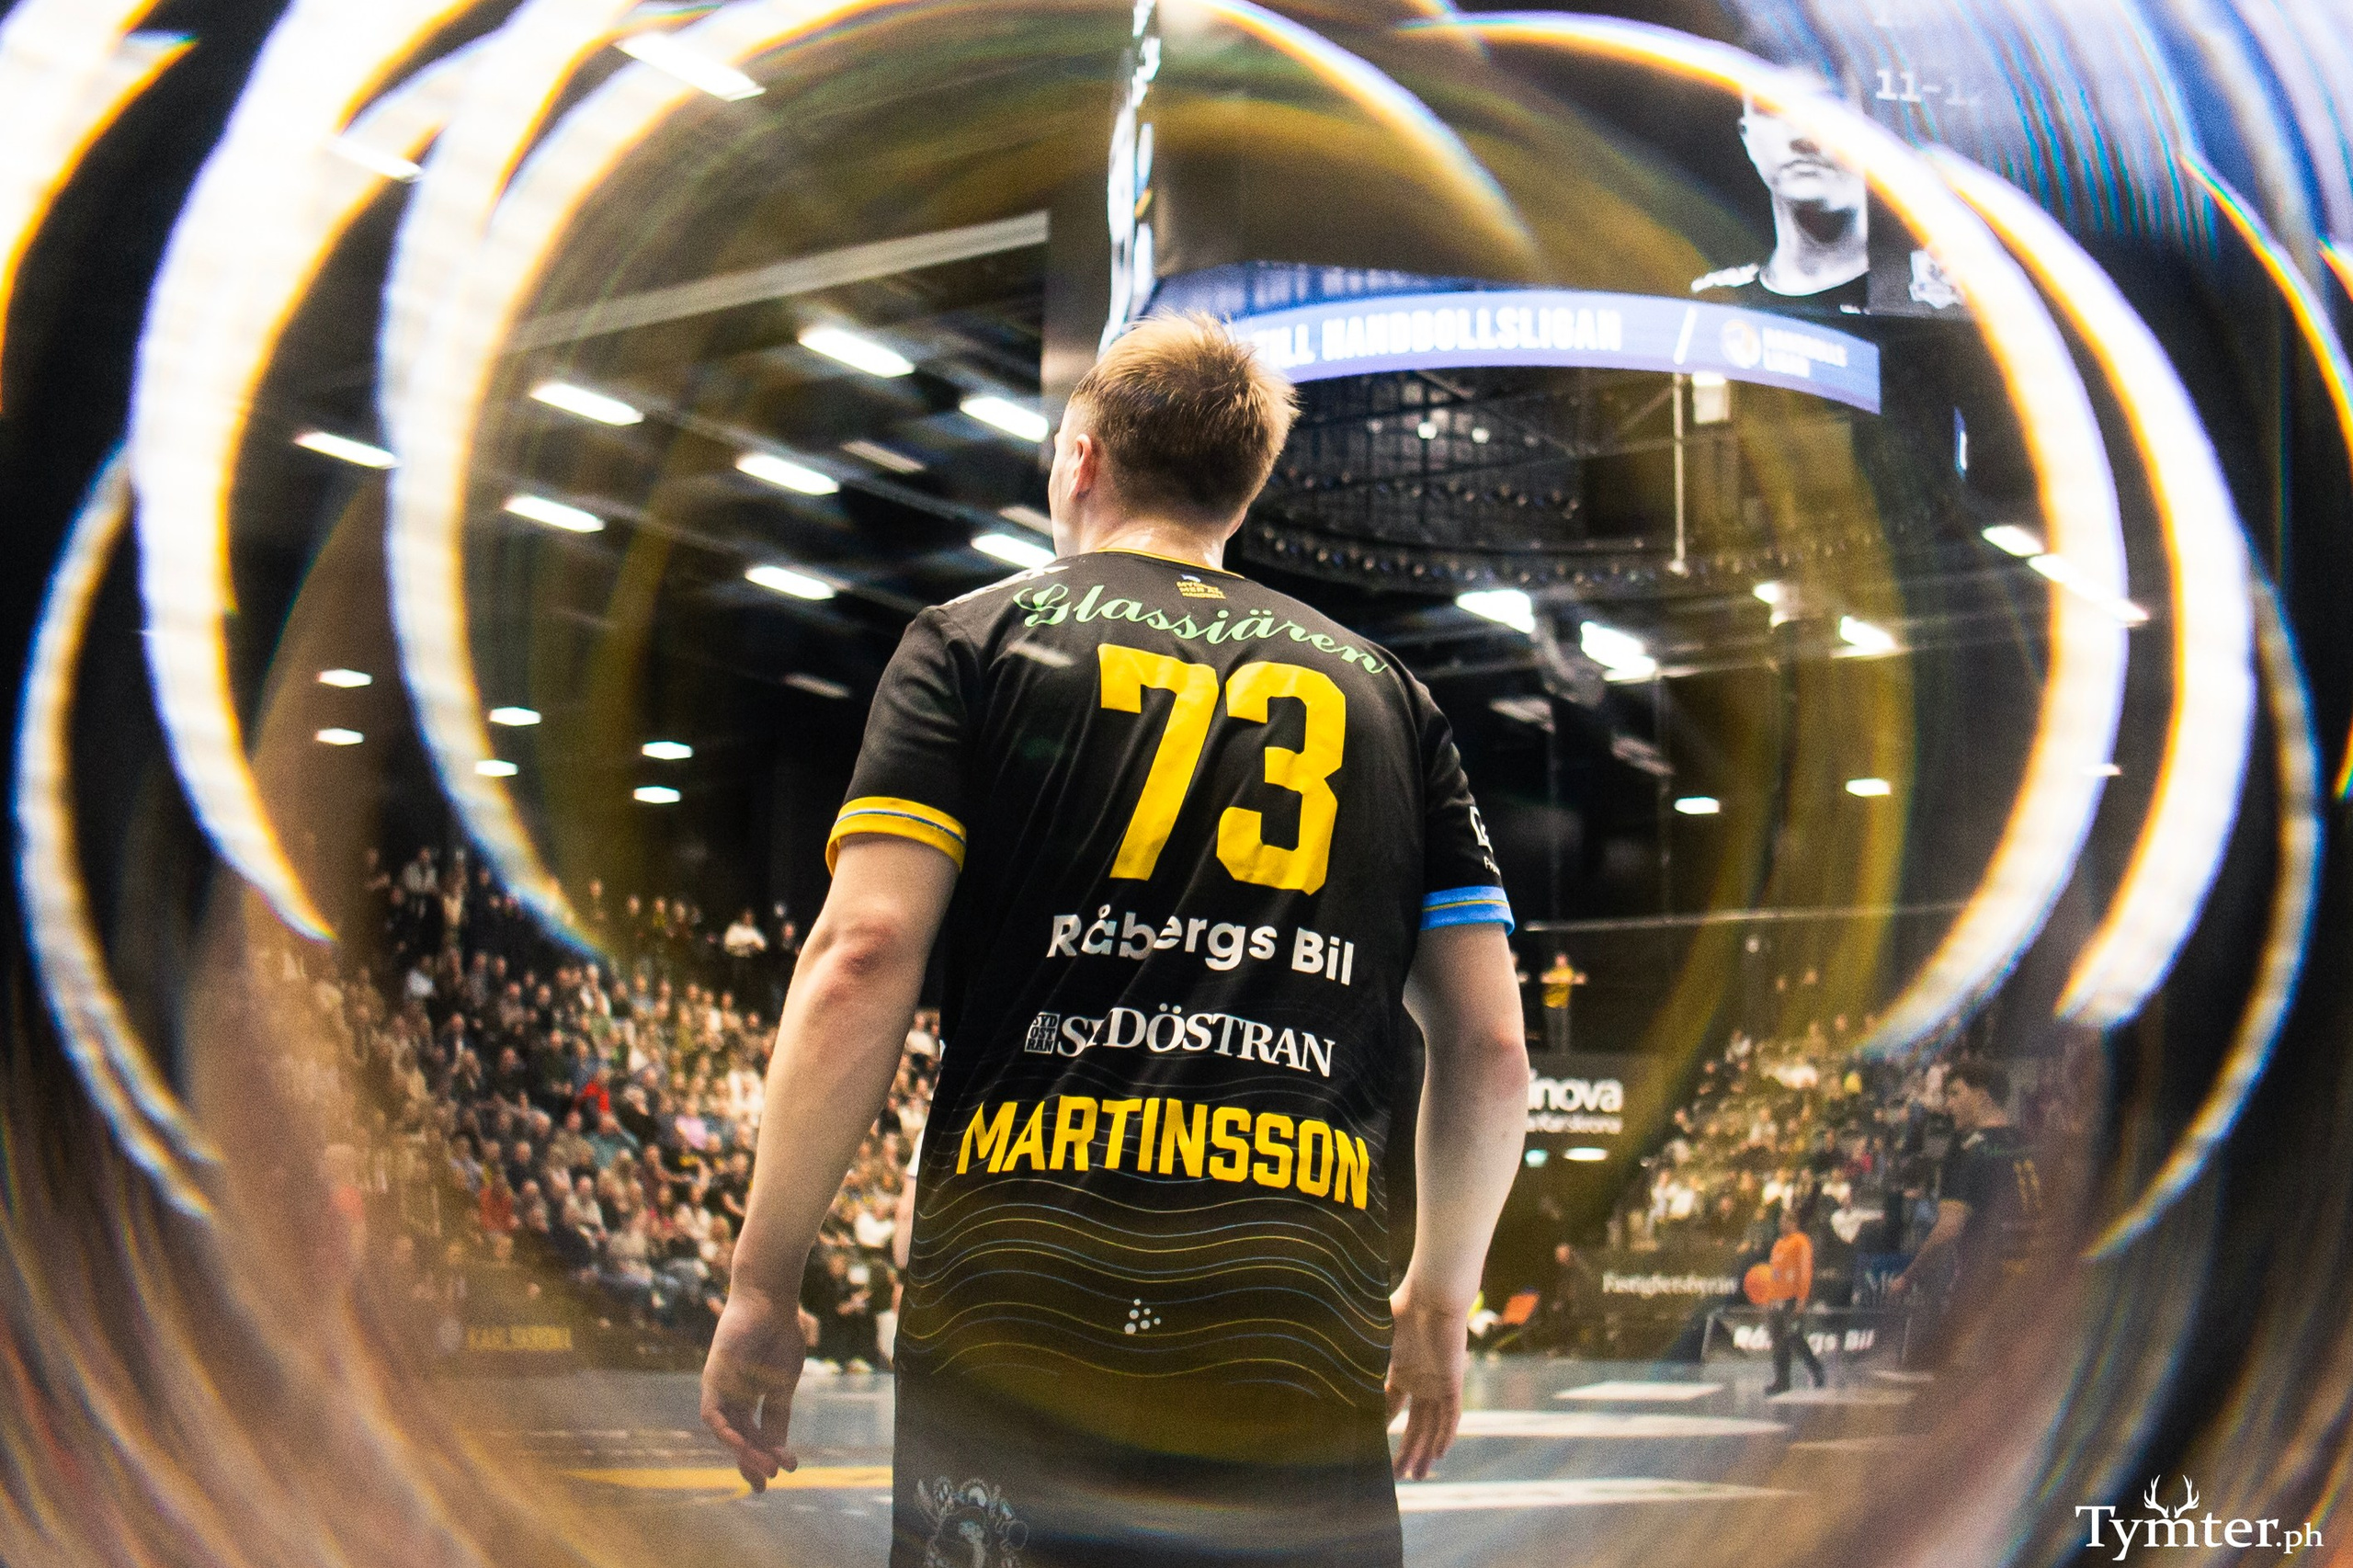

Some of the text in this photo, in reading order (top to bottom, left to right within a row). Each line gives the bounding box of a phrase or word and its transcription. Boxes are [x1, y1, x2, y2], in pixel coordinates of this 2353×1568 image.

[1321, 308, 1622, 361] HANDBOLLSLIGAN
[1013, 584, 1388, 674] Glassiären
[1098, 643, 1346, 896] 73
[1046, 903, 1355, 986] Råbergs Bil
[956, 1095, 1370, 1210] MARTINSSON
